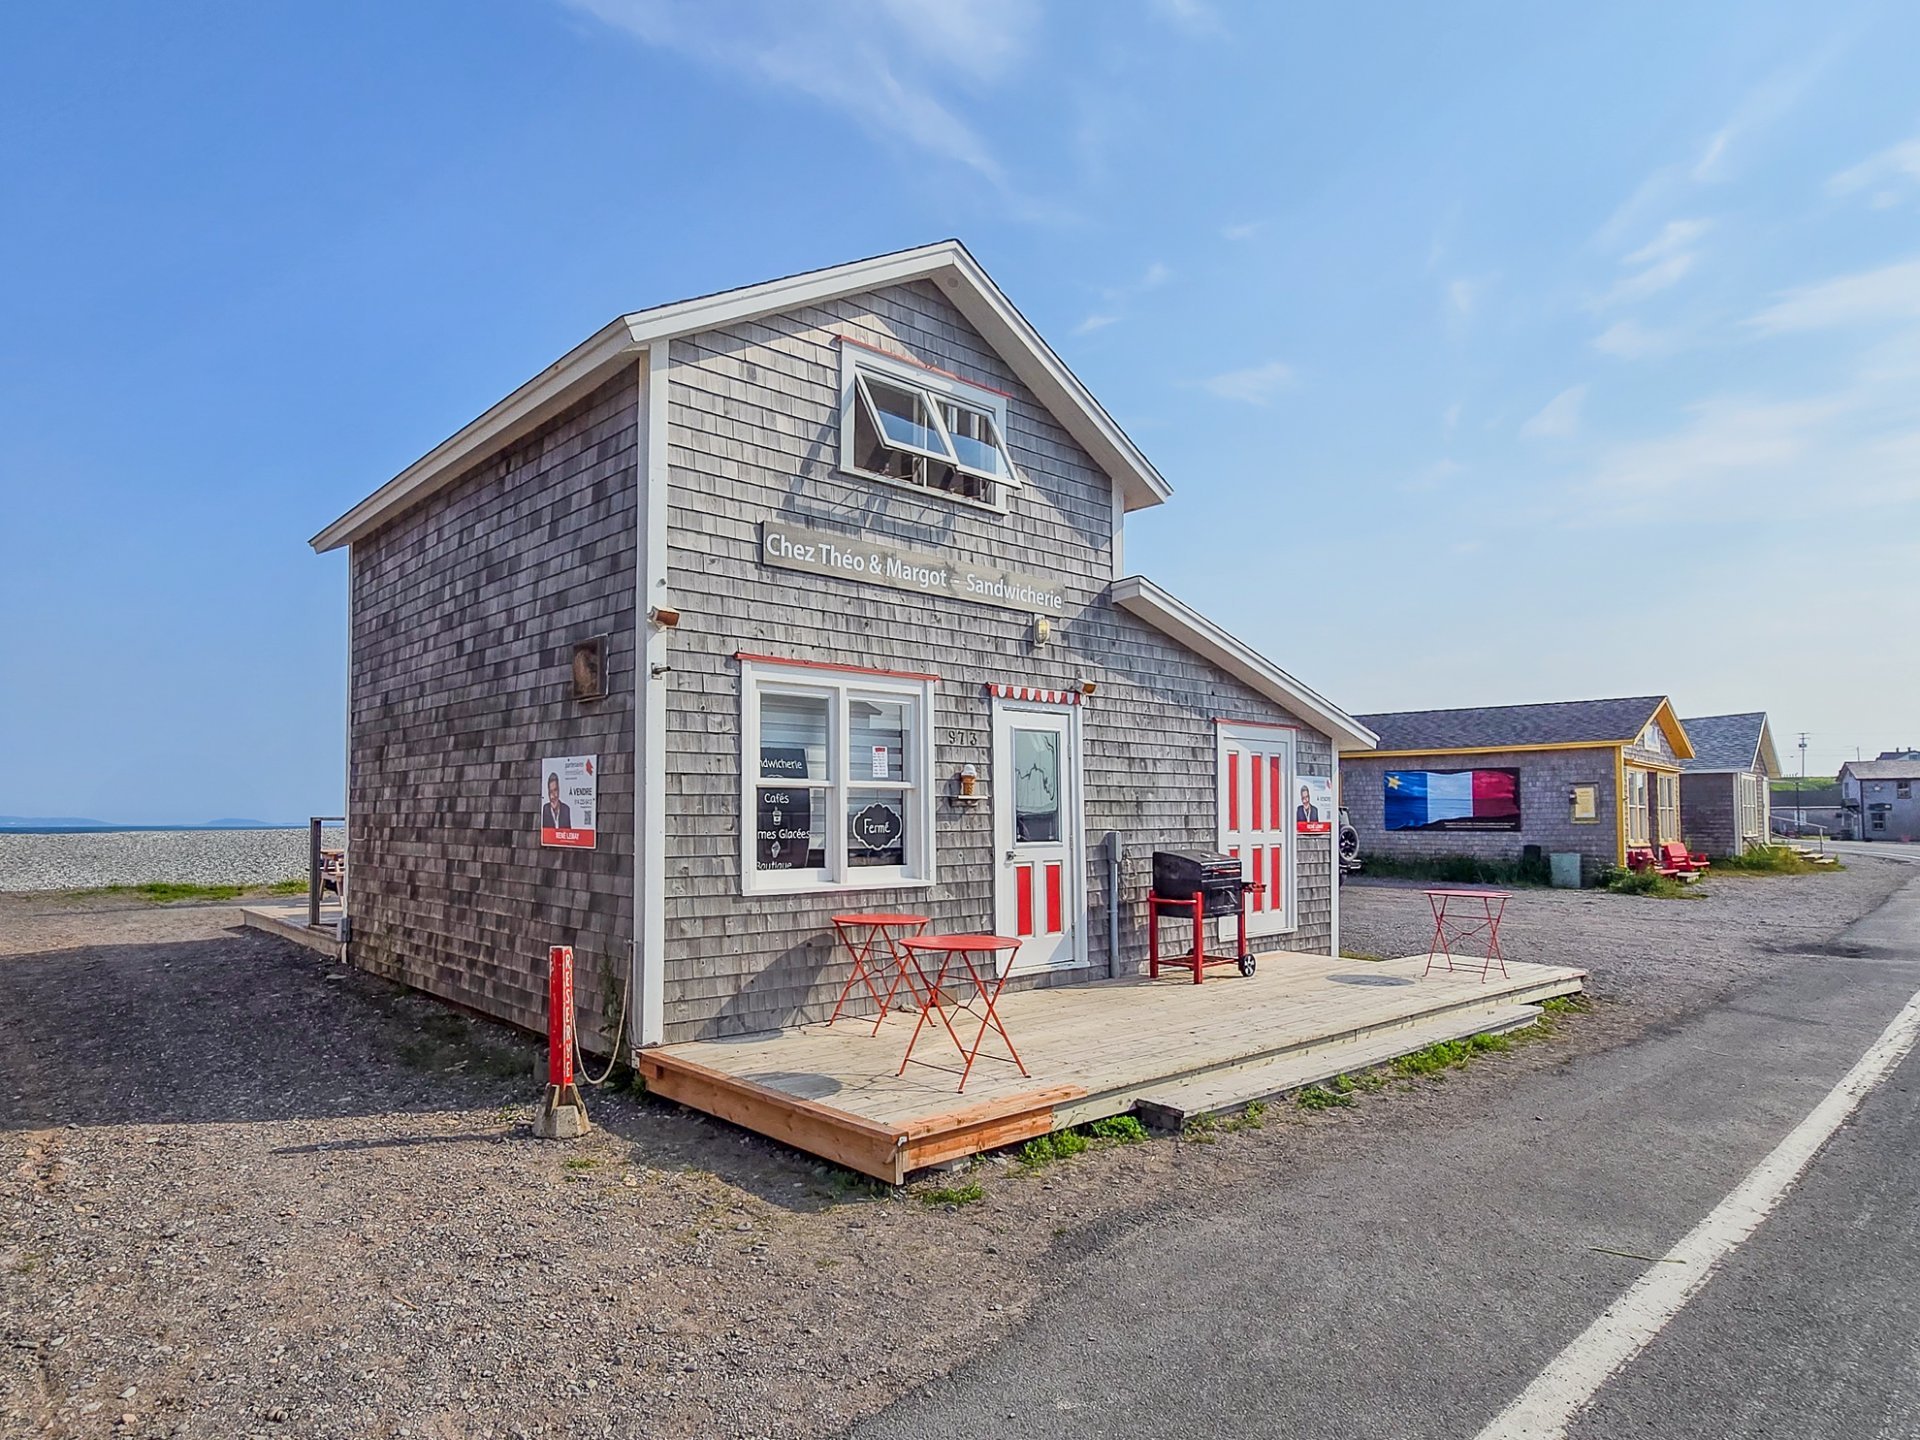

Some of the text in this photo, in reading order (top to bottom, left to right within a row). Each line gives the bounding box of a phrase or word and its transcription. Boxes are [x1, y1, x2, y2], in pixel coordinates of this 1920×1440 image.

[766, 533, 815, 563] Chez
[818, 543, 864, 571] Théo
[869, 555, 882, 574] &
[886, 557, 947, 588] Margot
[966, 574, 1062, 609] Sandwicherie
[948, 730, 978, 746] 973
[764, 792, 790, 804] Cafés
[778, 828, 811, 839] Glacées
[863, 818, 891, 835] Fermé
